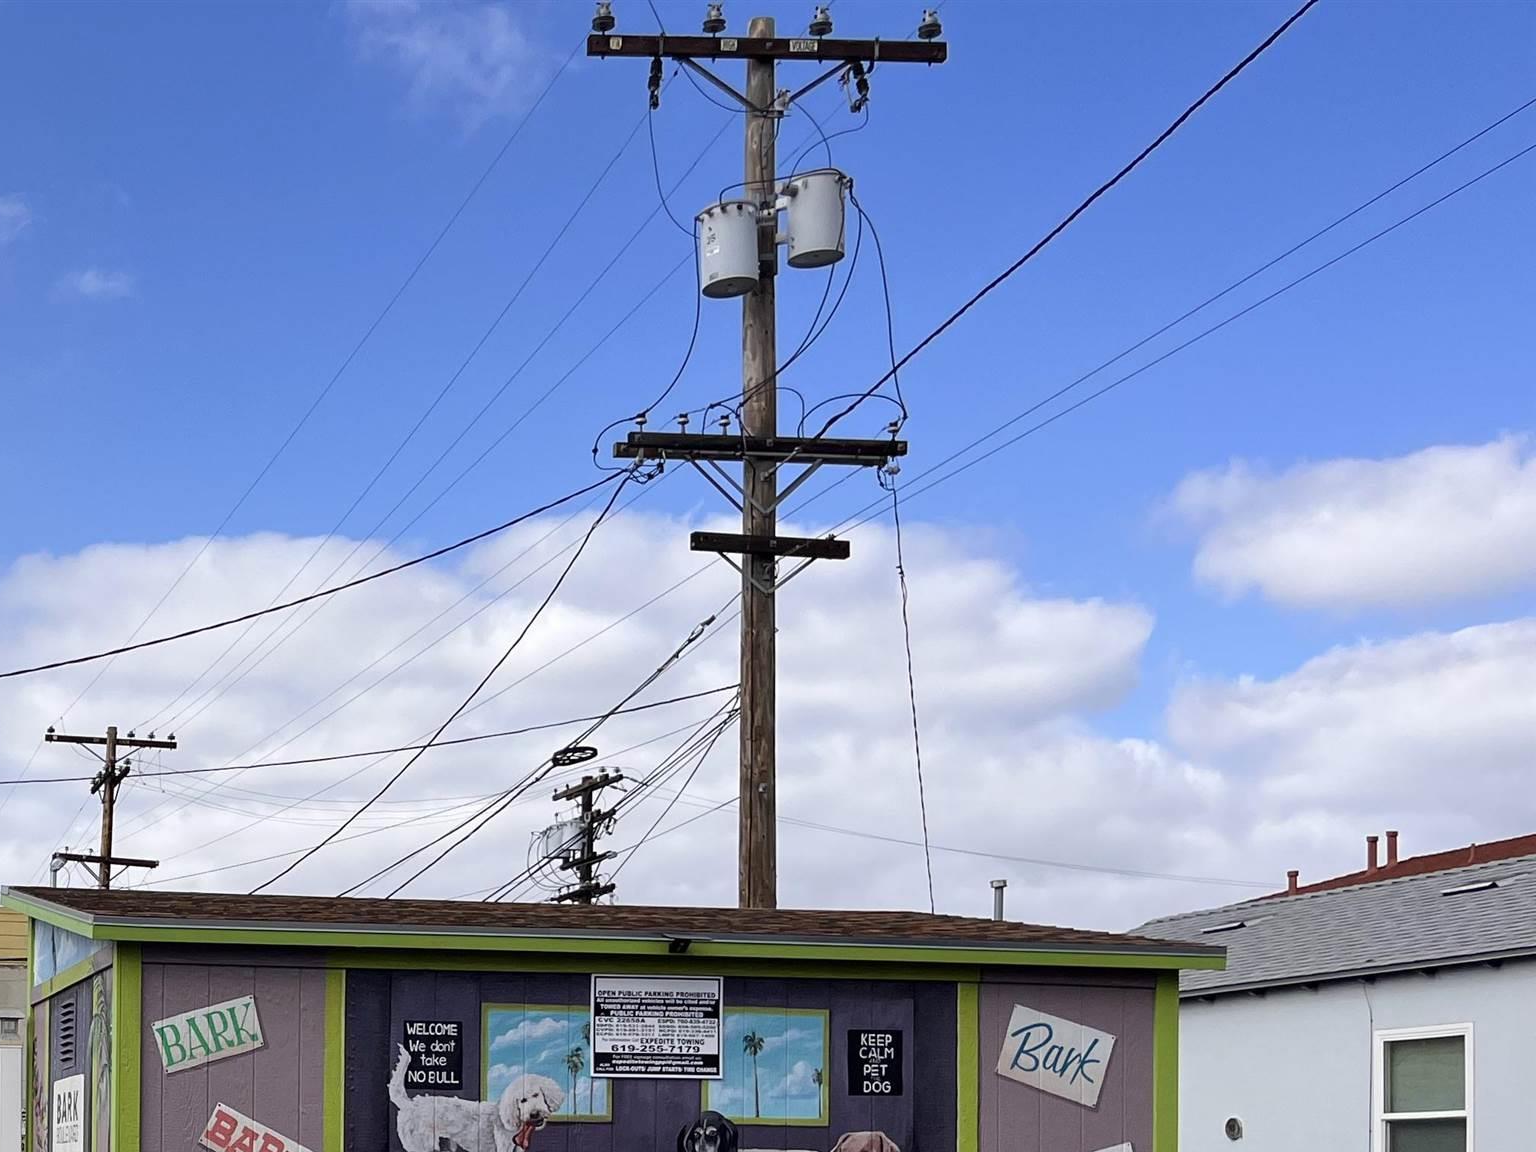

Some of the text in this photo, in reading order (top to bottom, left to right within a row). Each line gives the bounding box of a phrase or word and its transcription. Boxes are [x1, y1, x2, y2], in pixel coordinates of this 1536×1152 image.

[155, 1002, 258, 1067] BARK
[406, 1023, 458, 1035] WELCOME
[861, 1033, 892, 1046] KEEP
[409, 1040, 426, 1052] We
[611, 1045, 700, 1053] 619-255-7179
[859, 1047, 894, 1059] CALM
[1010, 1023, 1100, 1085] Bark
[420, 1054, 447, 1066] take
[864, 1064, 888, 1076] PET
[408, 1070, 459, 1083] NO BULL
[863, 1081, 891, 1093] DOG
[57, 1091, 78, 1124] BARK
